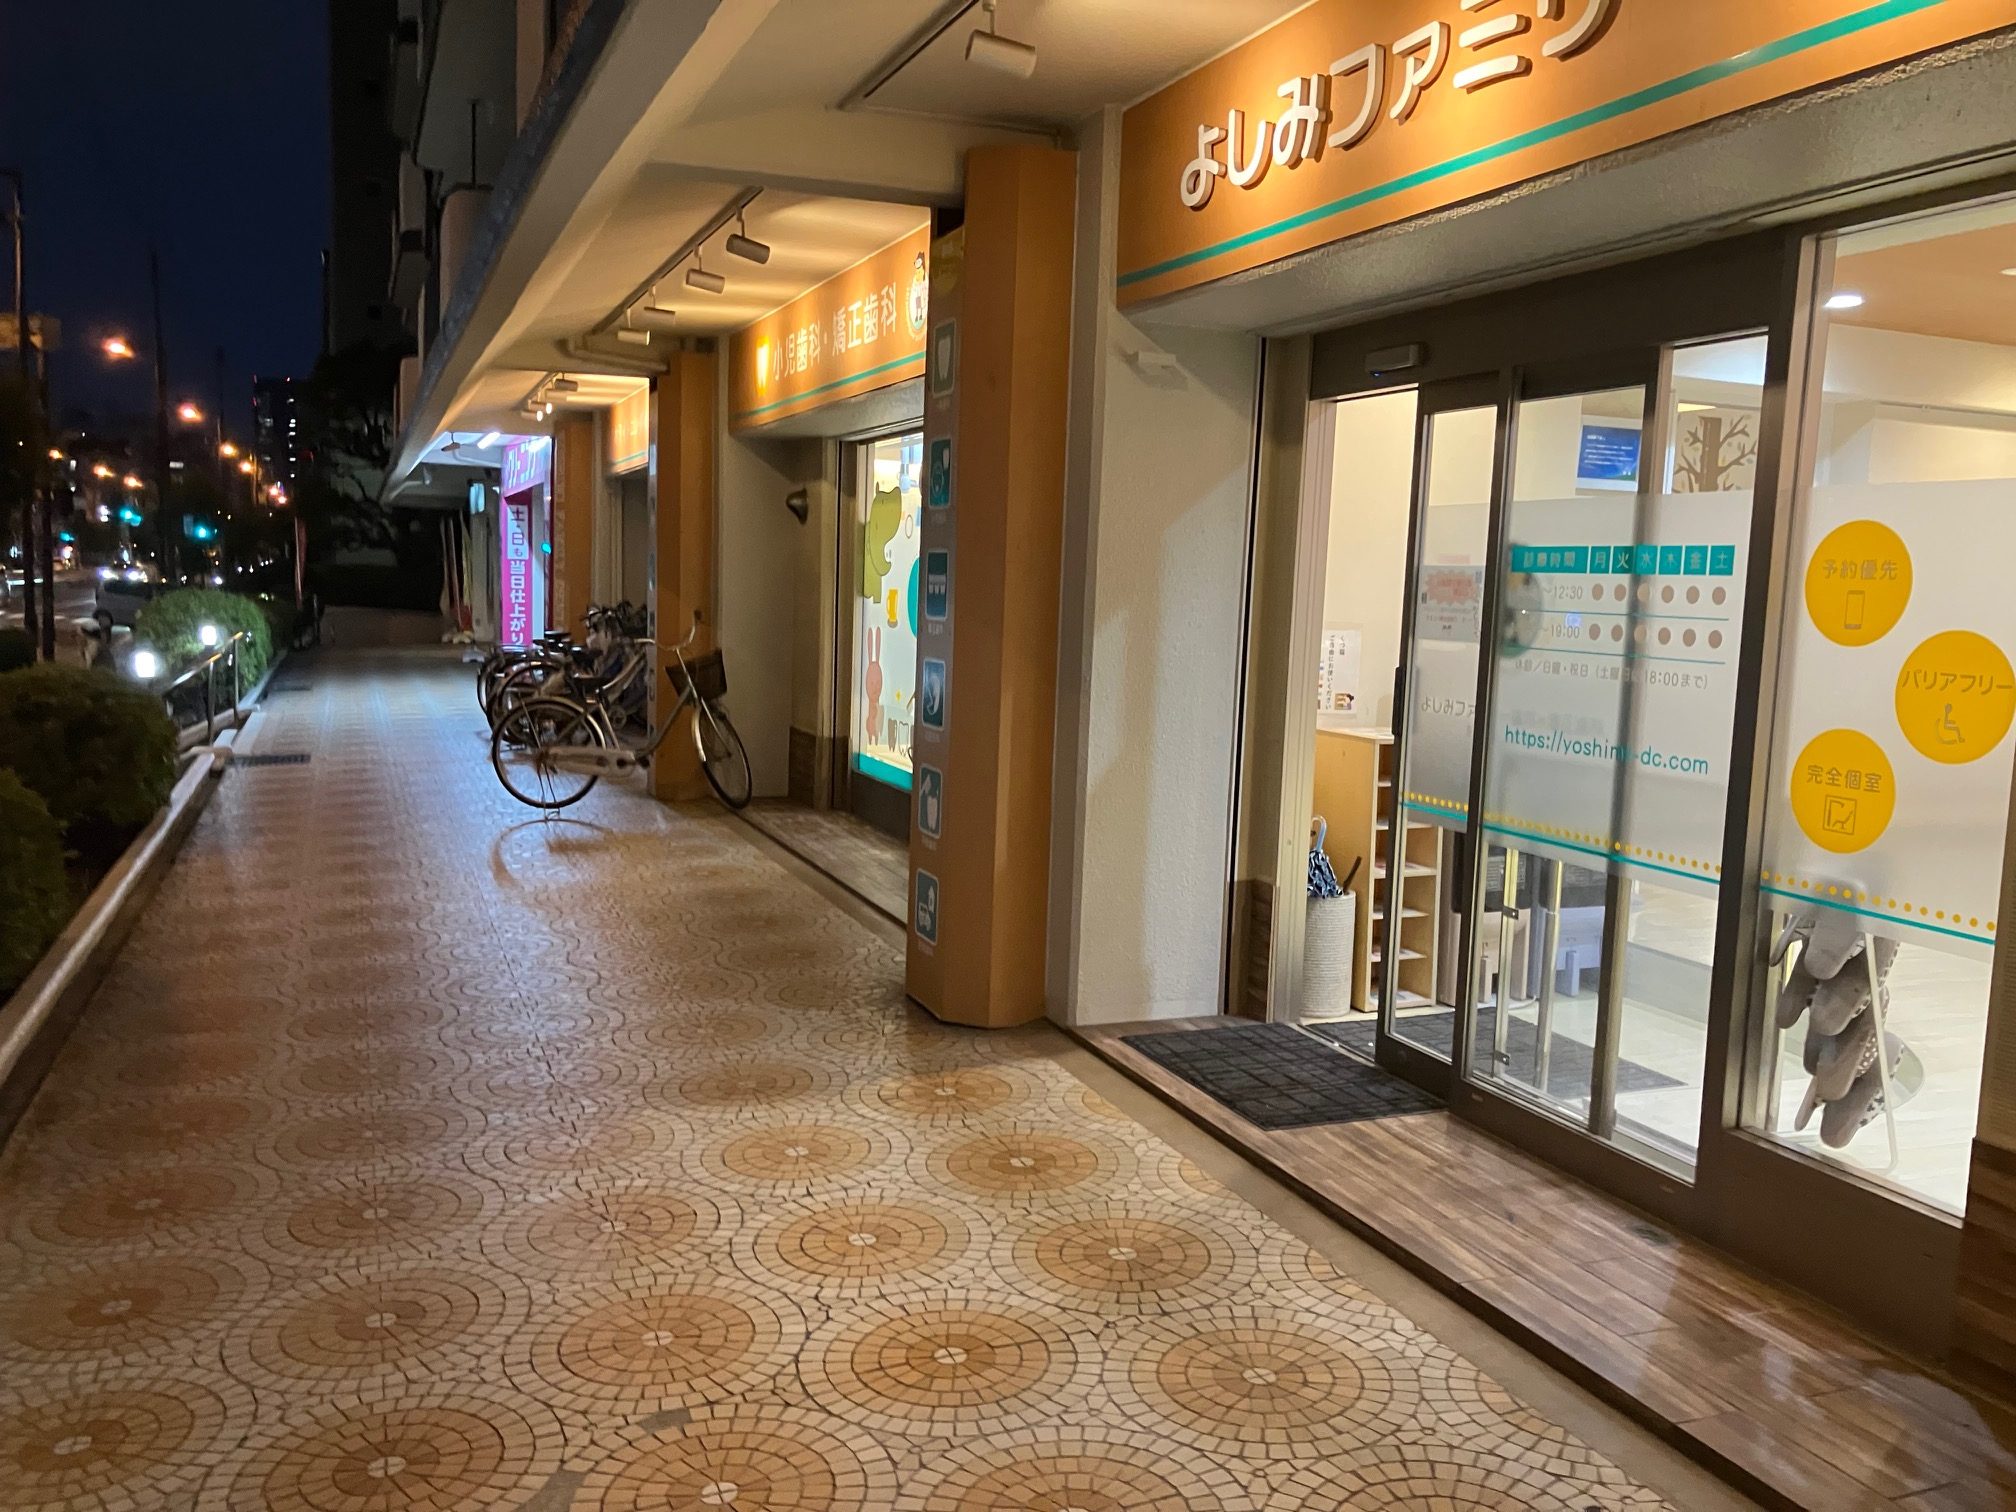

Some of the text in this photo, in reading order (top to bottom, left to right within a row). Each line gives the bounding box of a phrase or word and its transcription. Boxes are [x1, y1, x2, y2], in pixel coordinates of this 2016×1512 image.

[1594, 552, 1606, 568] 月
[1616, 552, 1630, 569] 火
[1640, 552, 1653, 568] 水
[1715, 551, 1728, 569] 土
[1822, 559, 1898, 581] 予約優先
[1901, 669, 2013, 695] バリアフリー
[1505, 725, 1709, 774] https://yoshim-dc.com
[1806, 764, 1882, 794] 完全個室
